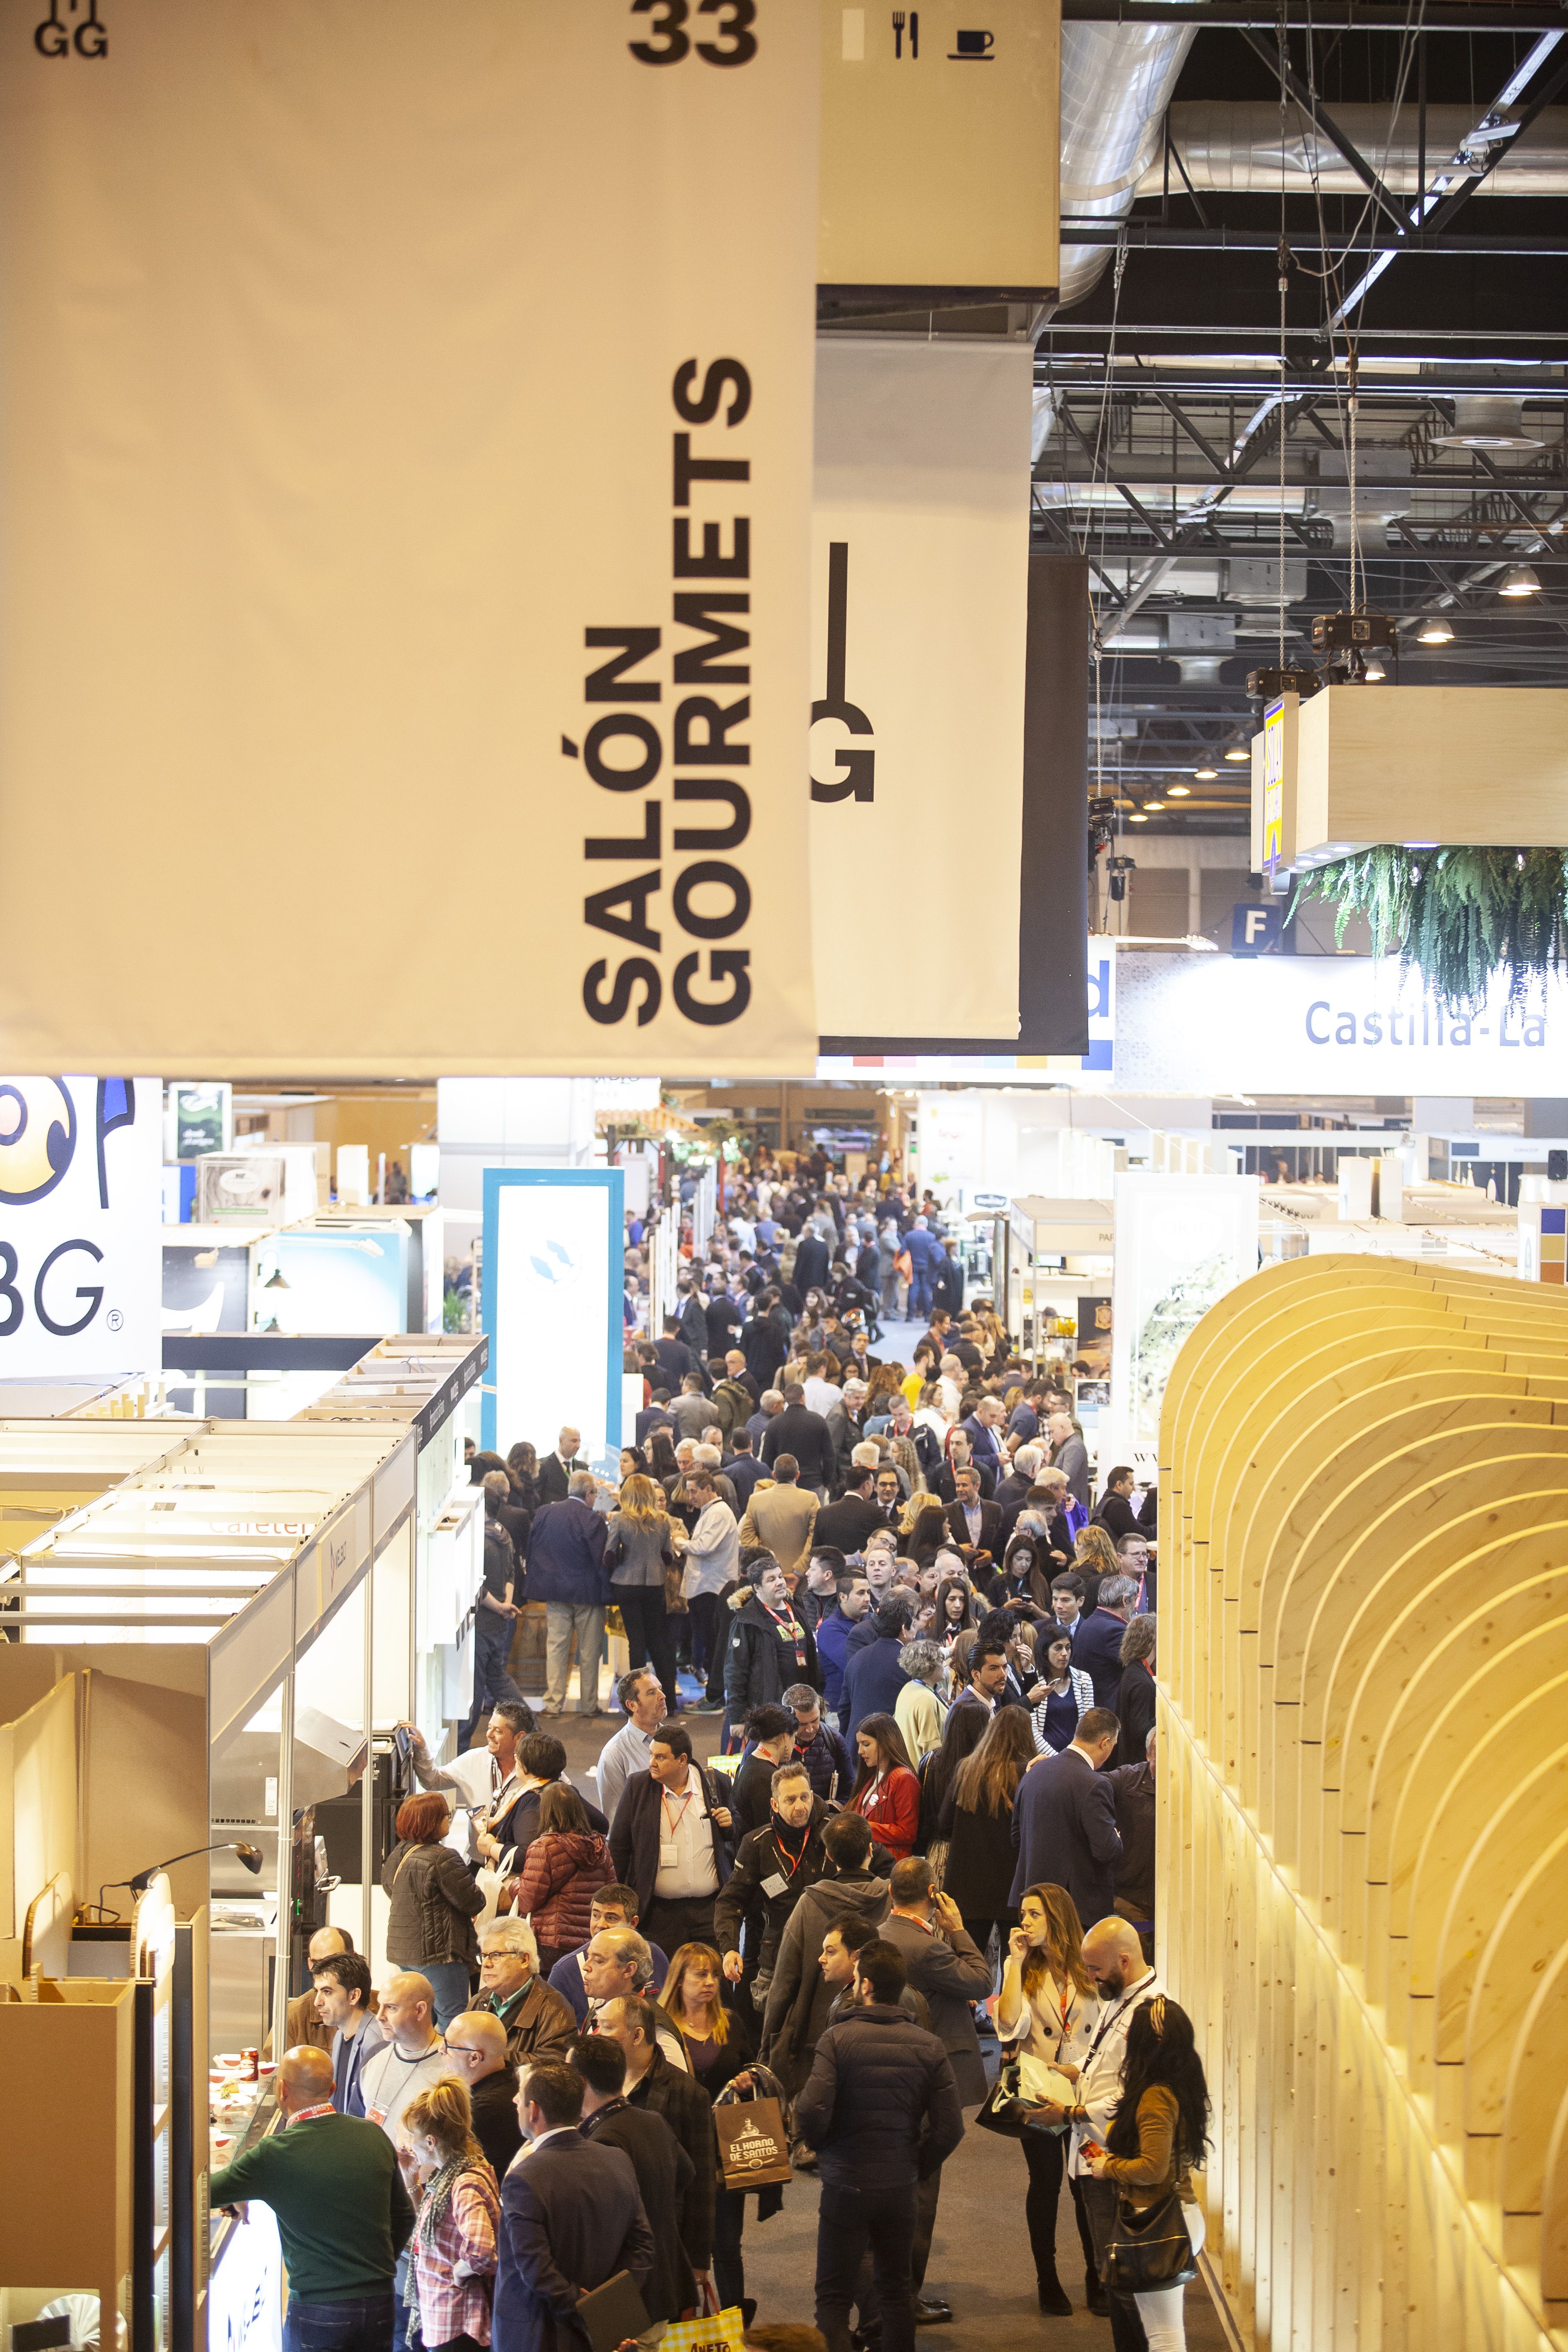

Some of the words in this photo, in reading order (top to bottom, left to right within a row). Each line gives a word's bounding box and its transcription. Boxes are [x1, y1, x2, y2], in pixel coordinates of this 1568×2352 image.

[628, 0, 759, 68] 33
[672, 356, 753, 1027] GOURMETS
[561, 626, 662, 1028] SALÓN
[1245, 910, 1266, 945] F
[730, 2143, 743, 2152] EL
[742, 2138, 774, 2150] HORNO
[730, 2152, 744, 2161] DE
[743, 2146, 778, 2159] SANTOS
